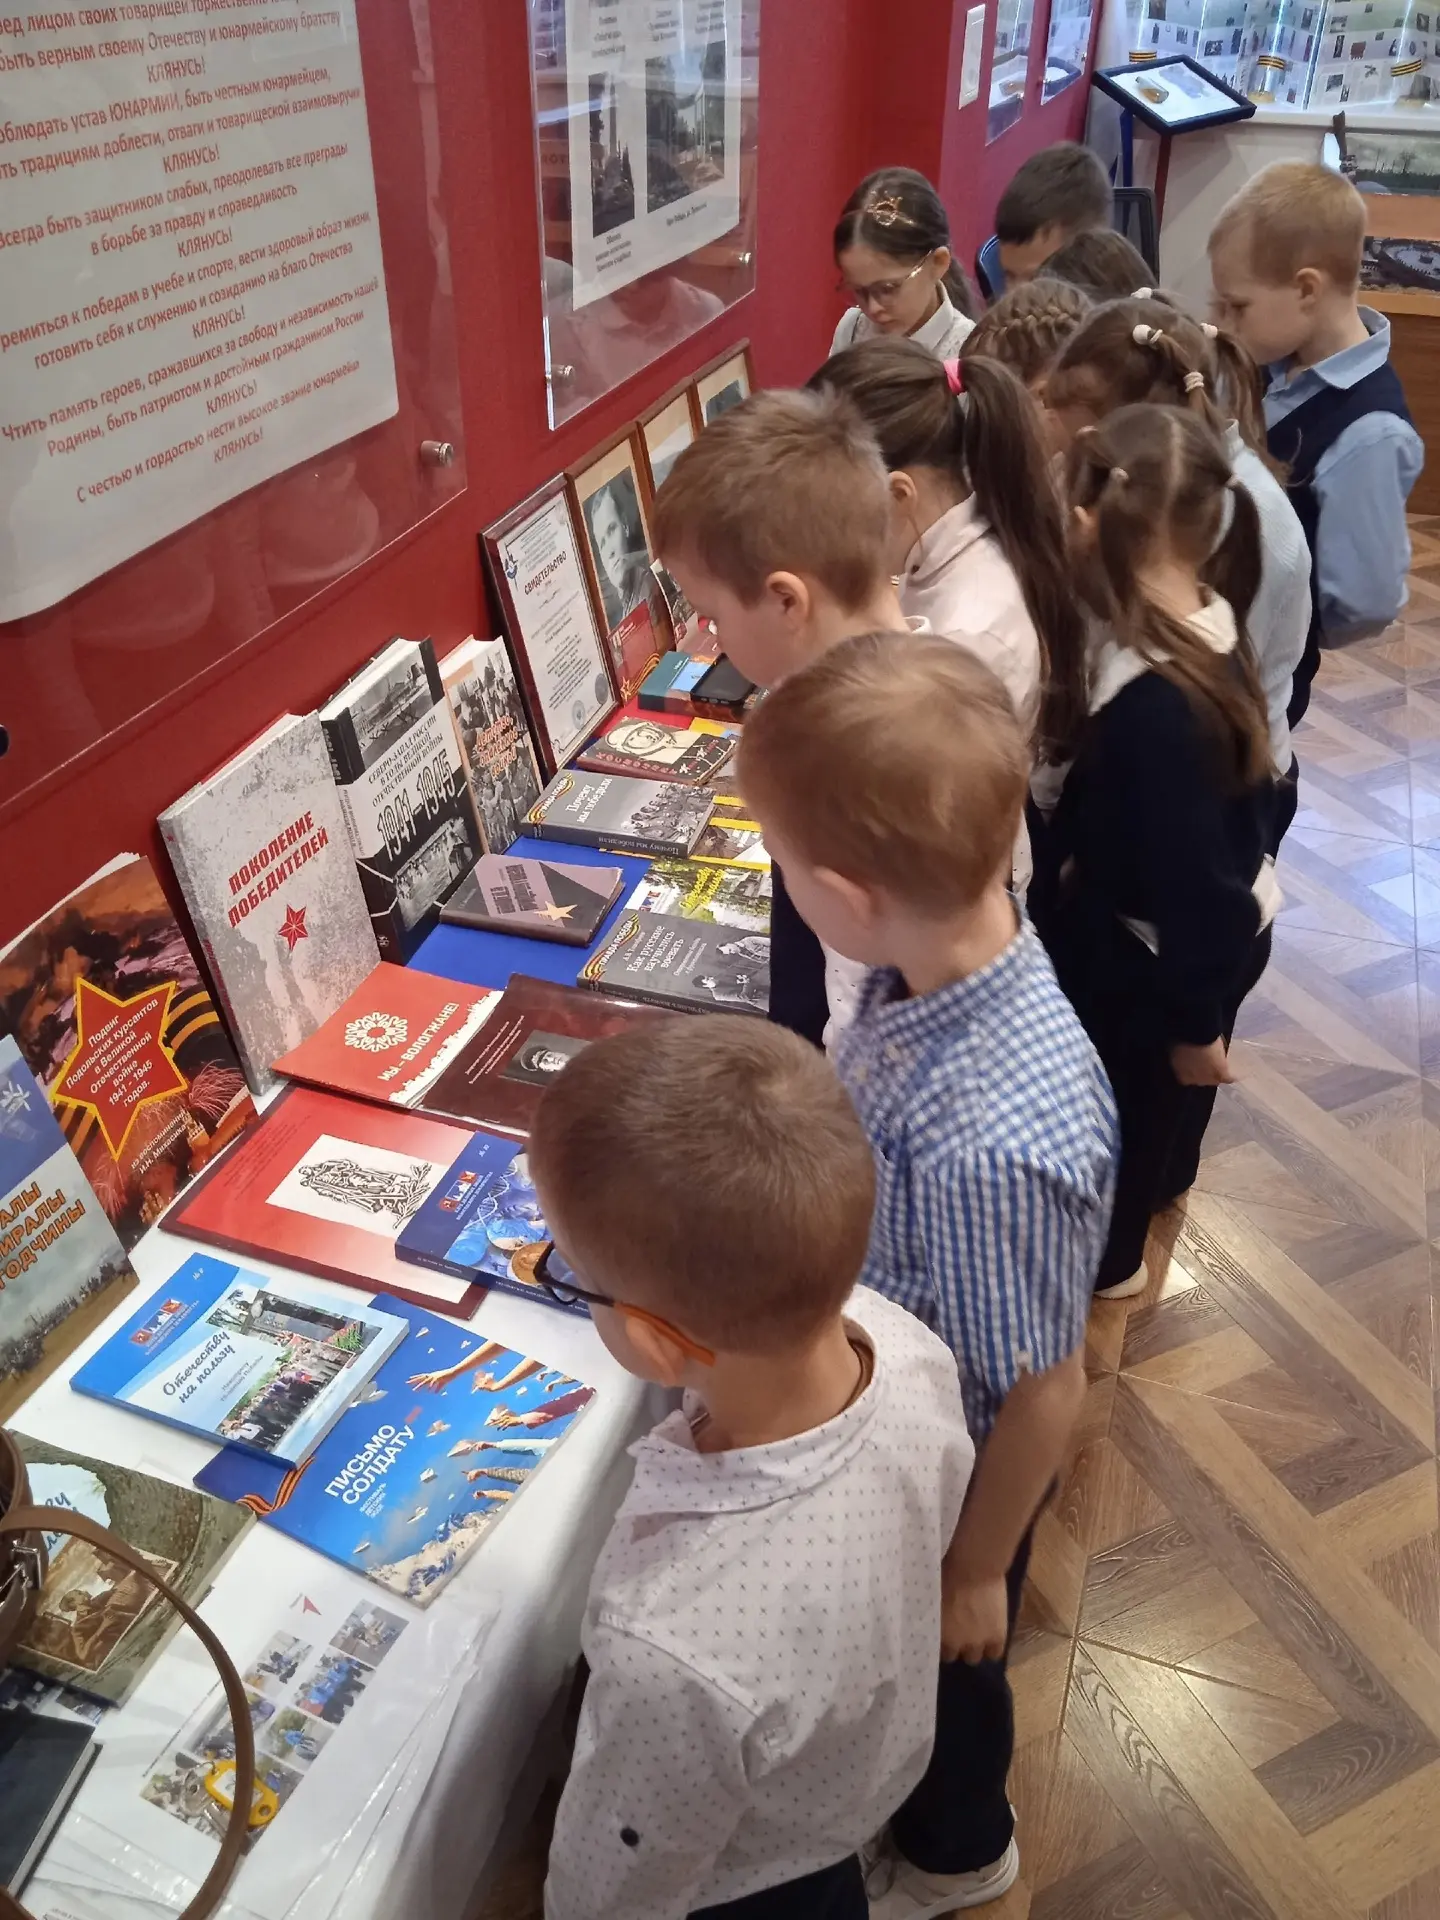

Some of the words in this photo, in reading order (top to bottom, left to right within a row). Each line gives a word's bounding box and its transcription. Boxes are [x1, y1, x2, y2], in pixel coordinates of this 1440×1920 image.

[28, 13, 76, 32] лицом
[79, 7, 118, 25] своих
[38, 45, 96, 69] верным
[99, 38, 144, 56] своему
[149, 29, 206, 50] Отечеству
[209, 28, 217, 42] и
[220, 17, 298, 40] юнармейскому
[301, 10, 341, 29] братству
[147, 56, 206, 83] КЛЯНУСЬ!
[71, 110, 107, 133] устав
[109, 92, 184, 122] ЮНАРМИИ,
[185, 89, 213, 108] быть
[215, 81, 262, 99] честным
[264, 67, 331, 92] юнармейцем,
[21, 143, 100, 177] традициям
[103, 132, 165, 160] доблести,
[168, 122, 204, 142] отваги
[208, 120, 215, 133] и
[216, 99, 291, 130] товарищеской
[163, 144, 220, 173] КЛЯНУСЬ!
[0, 224, 44, 249] Всегда
[47, 215, 82, 236] быть
[84, 192, 164, 226] защитником
[166, 179, 212, 203] слабых,
[213, 159, 284, 192] преодолевать
[286, 155, 301, 170] все
[304, 143, 347, 168] преграды
[91, 241, 99, 256] в
[102, 224, 147, 252] борьбе
[150, 223, 162, 238] за
[164, 212, 205, 236] правду
[209, 207, 216, 220] и
[218, 183, 298, 217] справедливость
[177, 226, 233, 258] КЛЯНУСЬ!
[0, 314, 69, 352] ремиться
[72, 310, 81, 325] к
[83, 290, 140, 322] победам
[142, 287, 149, 300] в
[151, 272, 185, 301] учебе
[187, 271, 195, 283] и
[198, 258, 237, 283] спорте,
[239, 247, 266, 266] вести
[268, 227, 314, 258] здоровый
[316, 220, 342, 240] образ
[34, 339, 94, 369] готовить
[96, 323, 124, 347] себя
[127, 321, 135, 334] к
[137, 298, 196, 332] служению
[200, 294, 207, 307] и
[269, 269, 280, 282] на
[281, 260, 307, 278] благо
[309, 241, 353, 267] Отечества
[192, 305, 246, 339] КЛЯНУСЬ!
[2, 418, 47, 441] Чтить
[50, 400, 98, 425] память
[100, 377, 146, 404] героев,
[147, 345, 222, 385] сражавшихся
[224, 340, 236, 354] за
[238, 322, 278, 348] свободу
[280, 318, 286, 330] и
[287, 291, 353, 325] независимость
[354, 276, 379, 298] нашей
[48, 425, 105, 457] Родины,
[106, 410, 137, 431] быть
[140, 383, 201, 417] патриотом
[203, 377, 211, 389] и
[214, 350, 271, 389] достойным
[273, 324, 335, 360] гражданином
[335, 310, 364, 332] России
[206, 379, 258, 415] КЛЯНУСЬ!
[77, 487, 86, 503] С
[88, 468, 133, 496] честью
[135, 464, 143, 476] и
[146, 433, 204, 471] гордостью
[207, 420, 236, 442] нести
[238, 398, 278, 428] высокое
[280, 382, 311, 407] звание
[214, 427, 263, 463] КЛЯНУСЬ!
[524, 551, 567, 595] СВИДЕТЕЛЬСТВО
[368, 737, 413, 784] СЕВЕРО-ЗАПАД
[412, 714, 437, 743] РОССИИ
[372, 756, 423, 807] ОТЕЧЕСТВЕННОЙ
[422, 733, 444, 760] ВОЙНЫ
[403, 733, 432, 764] ВЕЛИКОЙ
[565, 784, 595, 812] Почему
[587, 777, 613, 810] победили
[228, 810, 314, 896] ПОКОЛЕНИЕ
[598, 836, 635, 847] победили
[650, 842, 679, 856] Почему
[228, 825, 329, 928] ПОБЕДИТЕЛЕЙ
[626, 956, 645, 972] Как
[640, 925, 666, 958] русские
[644, 931, 675, 972] научились
[661, 938, 684, 968] воевать
[66, 1038, 114, 1089] Подольских
[113, 999, 158, 1040] курсантов
[88, 1015, 120, 1047] Подвиг
[94, 1066, 100, 1075] в
[100, 1030, 137, 1067] Великой
[377, 1065, 400, 1081] МЫ
[401, 1002, 459, 1061] ВОЛОГЖАНЕ!
[90, 1031, 153, 1094] Отечественной
[109, 1084, 128, 1105] 1941
[132, 1059, 153, 1081] 1945
[112, 1060, 138, 1087] войне
[123, 1081, 150, 1107] годов.
[131, 1158, 139, 1169] из
[139, 1109, 186, 1160] воспоминаний
[0, 1181, 42, 1230] АЛЫ
[0, 1188, 66, 1258] ИРАЛЫ
[163, 1330, 230, 1396] Отечеству
[178, 1385, 197, 1404] на
[196, 1343, 236, 1384] пользу
[324, 1424, 395, 1498] ПИСЬМО
[342, 1424, 415, 1504] СОЛДАТУ
